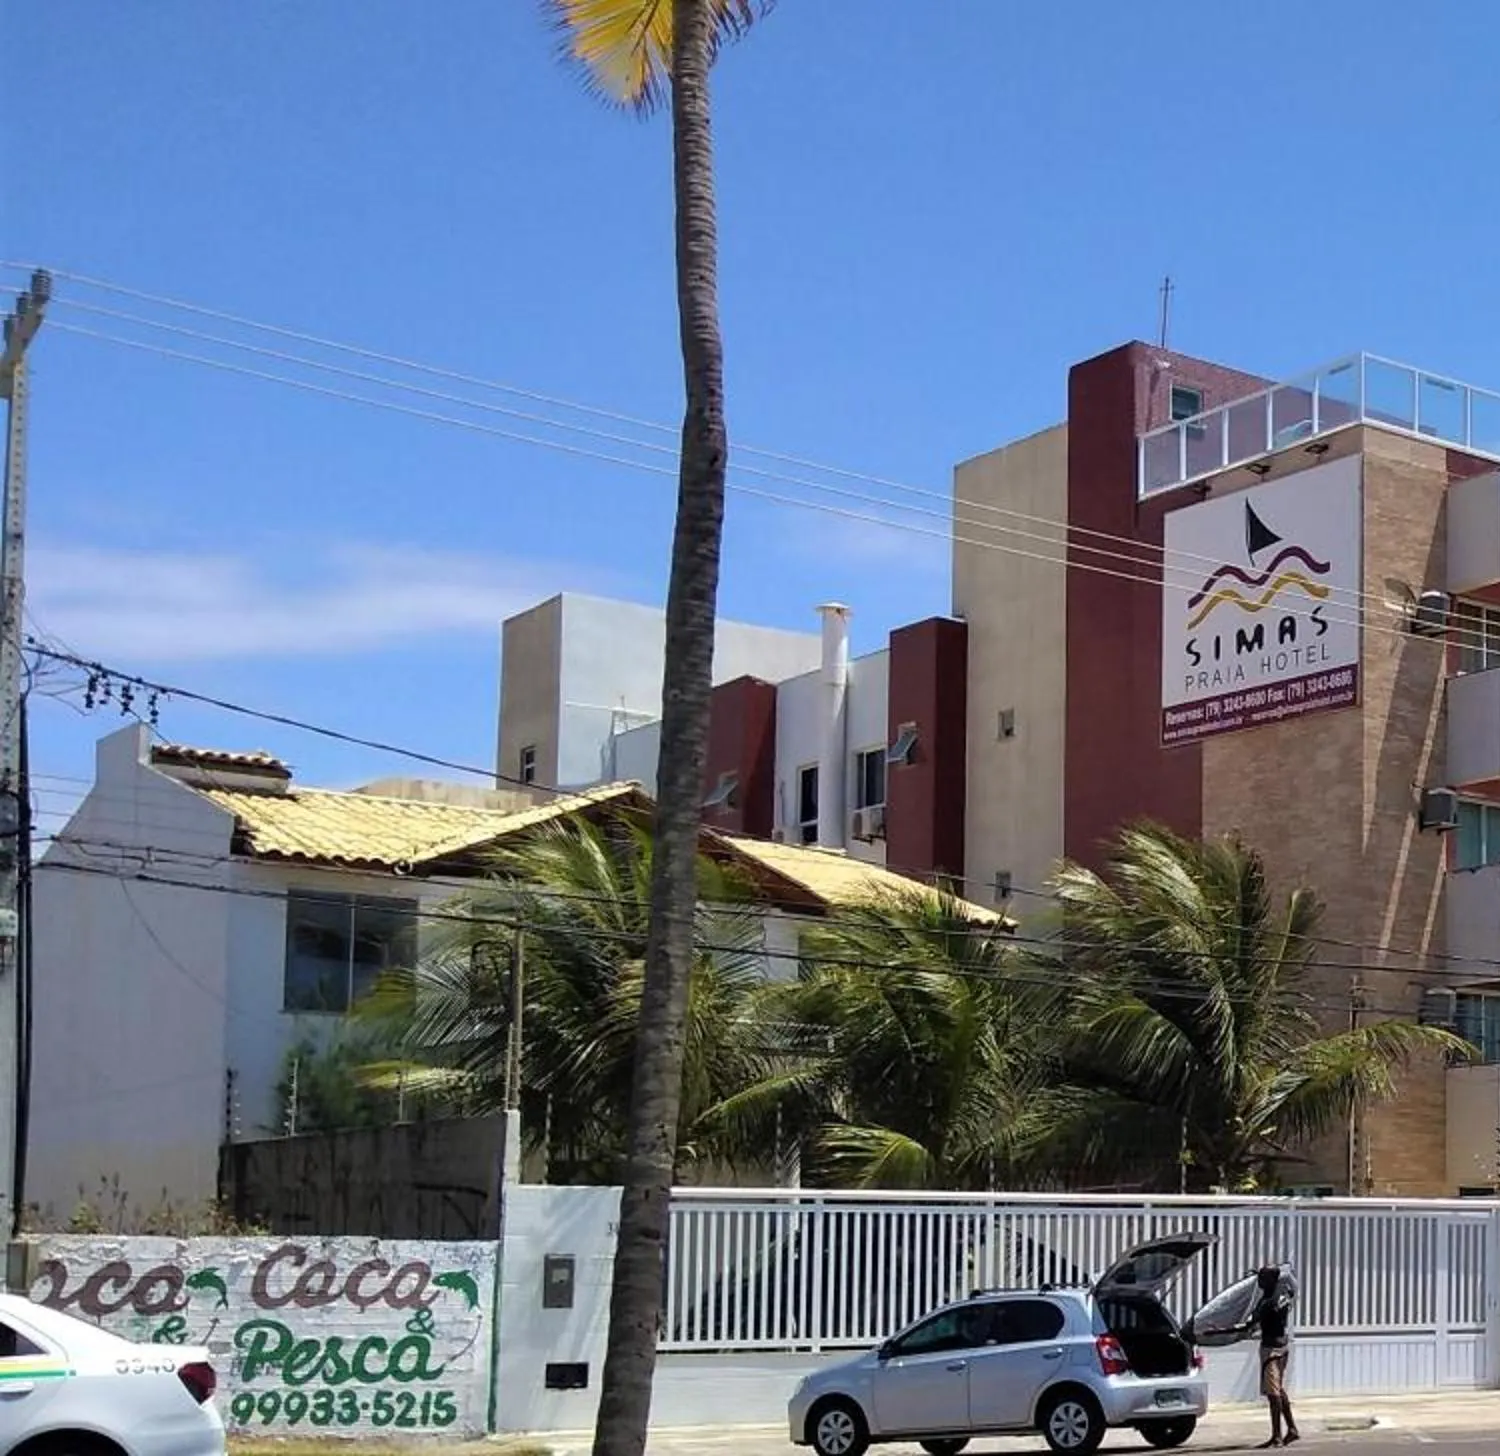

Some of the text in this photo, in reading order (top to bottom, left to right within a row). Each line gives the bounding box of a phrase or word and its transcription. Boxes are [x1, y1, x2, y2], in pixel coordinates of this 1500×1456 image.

[1185, 606, 1329, 667] SIMAS
[1184, 642, 1330, 692] PRAIA HOTEL
[405, 1308, 435, 1338] &
[234, 1318, 446, 1386] Pesca
